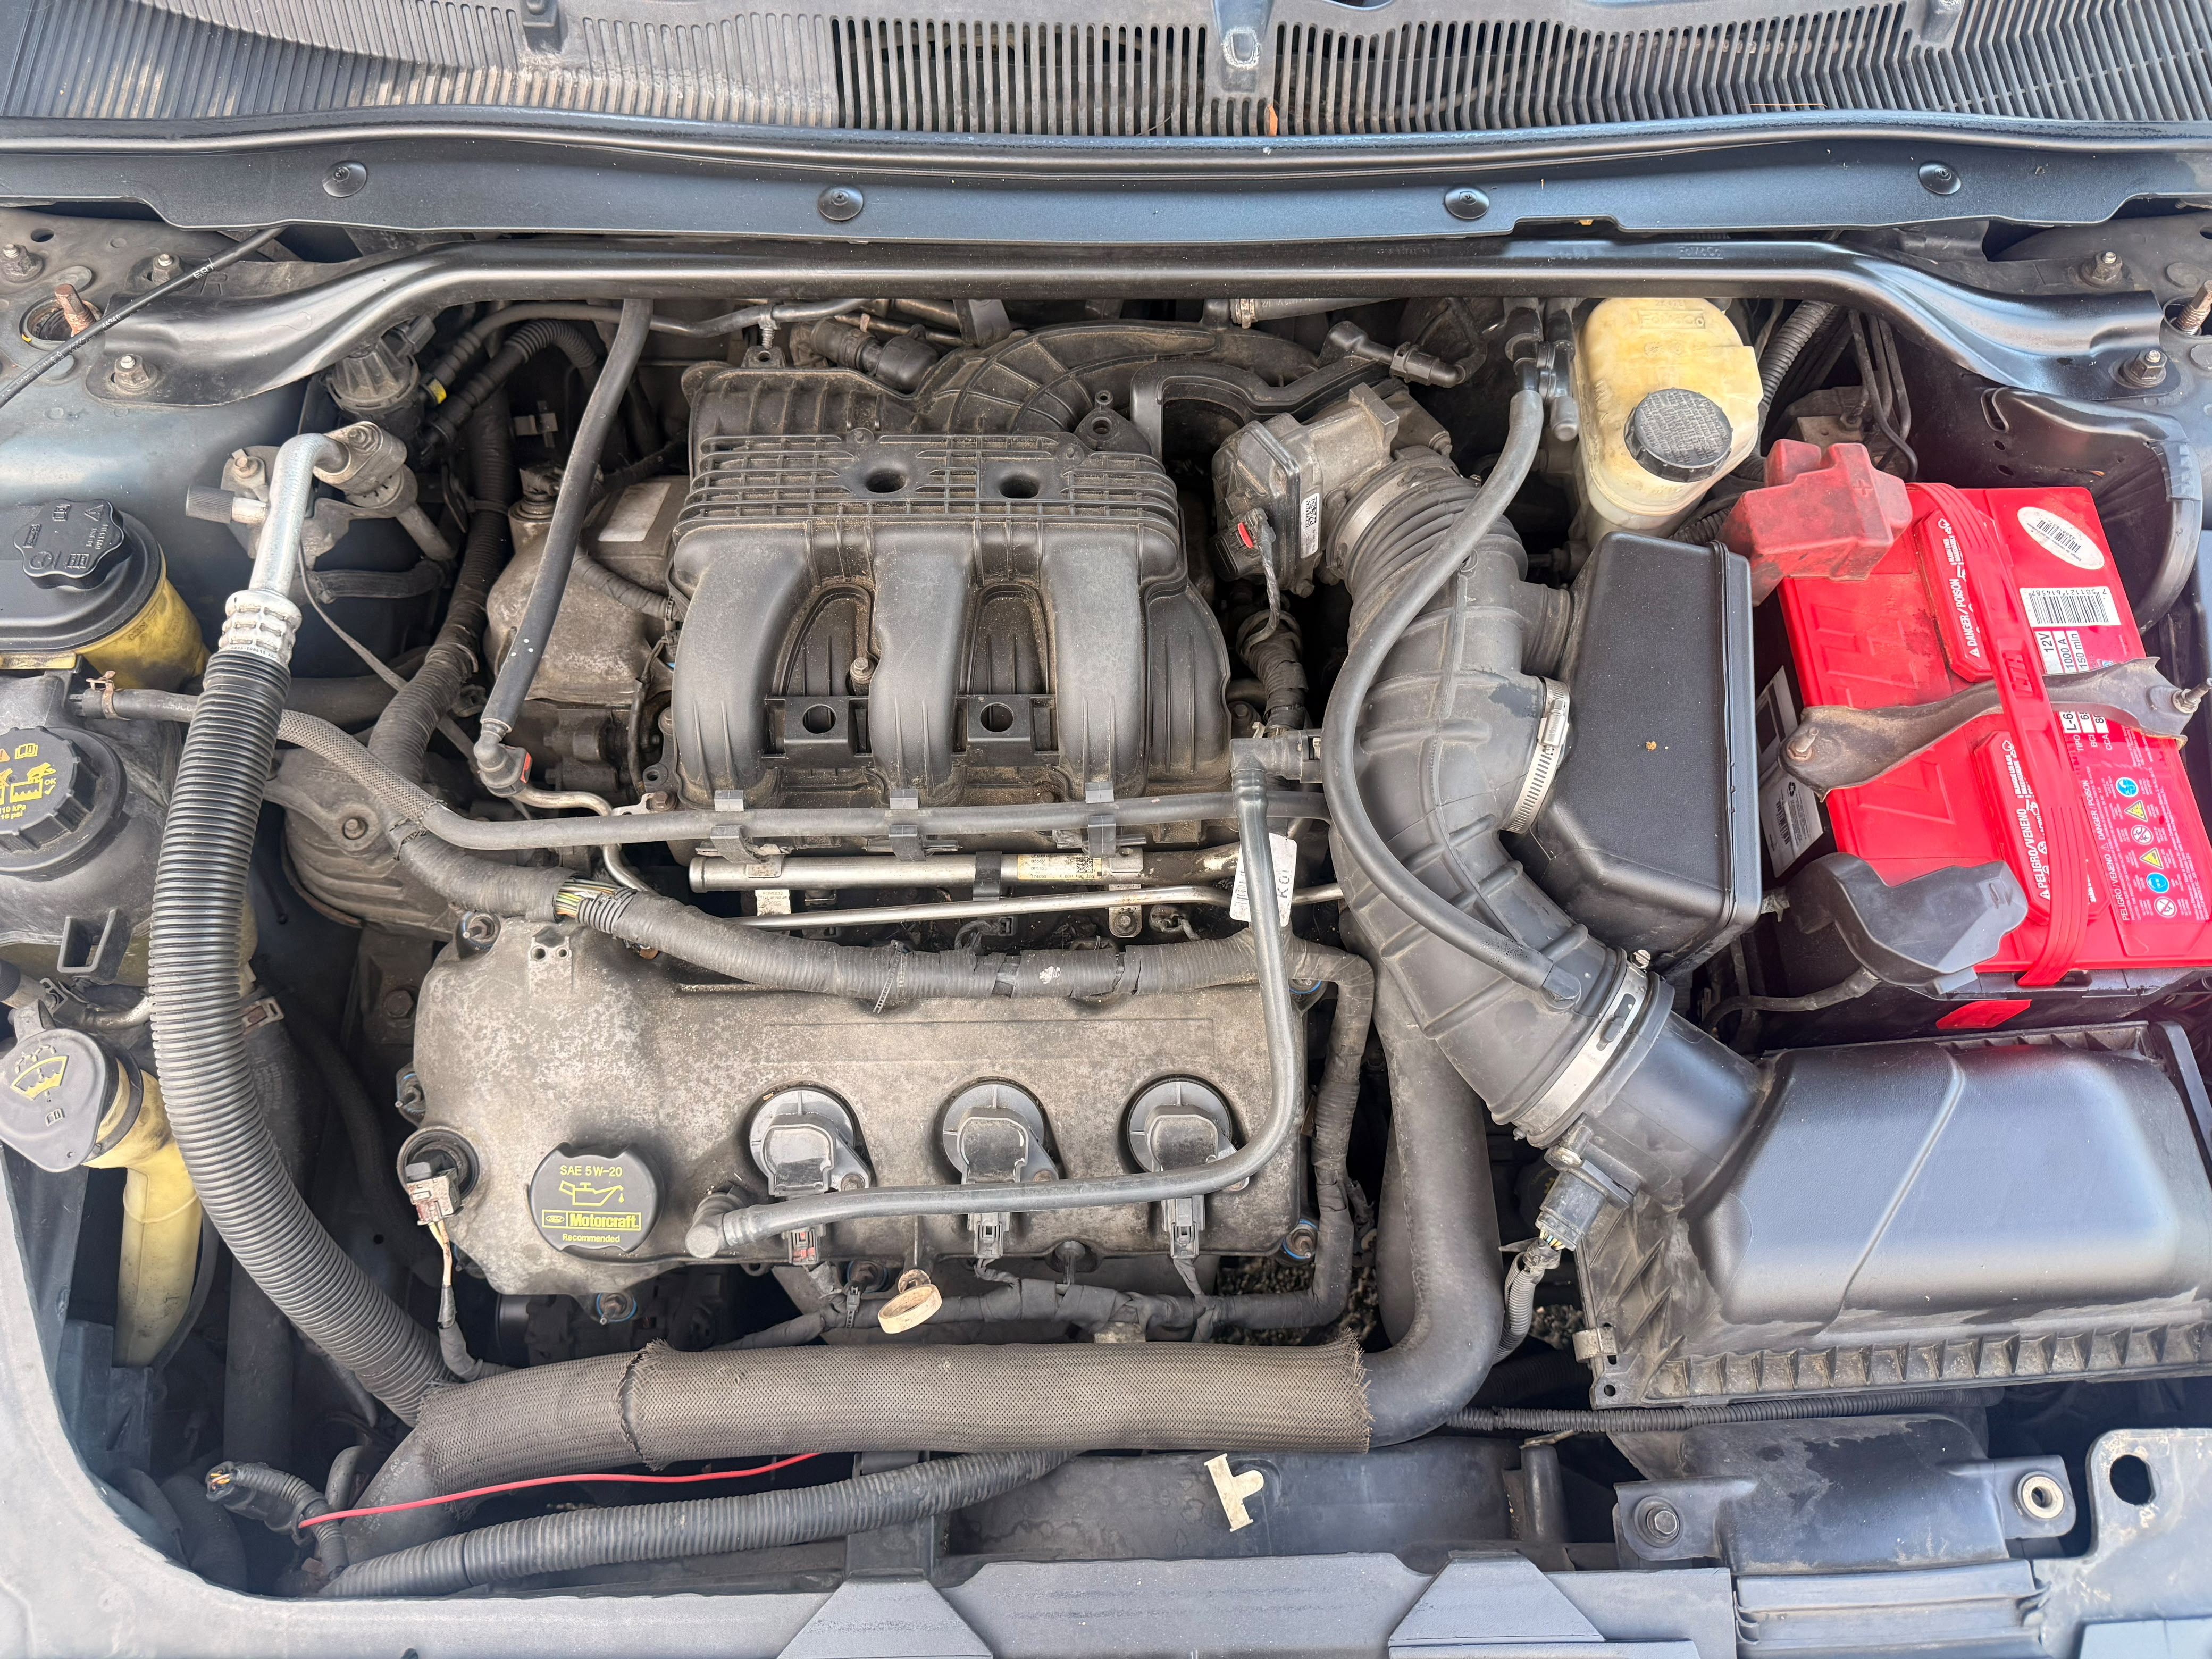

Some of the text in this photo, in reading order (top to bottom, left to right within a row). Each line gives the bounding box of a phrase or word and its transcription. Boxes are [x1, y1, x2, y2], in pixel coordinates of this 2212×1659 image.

[2038, 633, 2054, 652] 12V
[2071, 633, 2088, 668] 150 min
[2060, 648, 2074, 669] 1000
[2063, 711, 2084, 752] TIPO L-6
[2088, 734, 2098, 748] BCI
[2102, 734, 2113, 750] CCA
[2082, 780, 2093, 806] POISON
[11, 810, 23, 820] psi
[2091, 810, 2104, 839] DANGER
[2105, 854, 2117, 883] VENENO
[2115, 889, 2128, 920] PELIGRO
[559, 1166, 623, 1177] SAE 5W-20
[562, 1233, 621, 1243] Recommended
